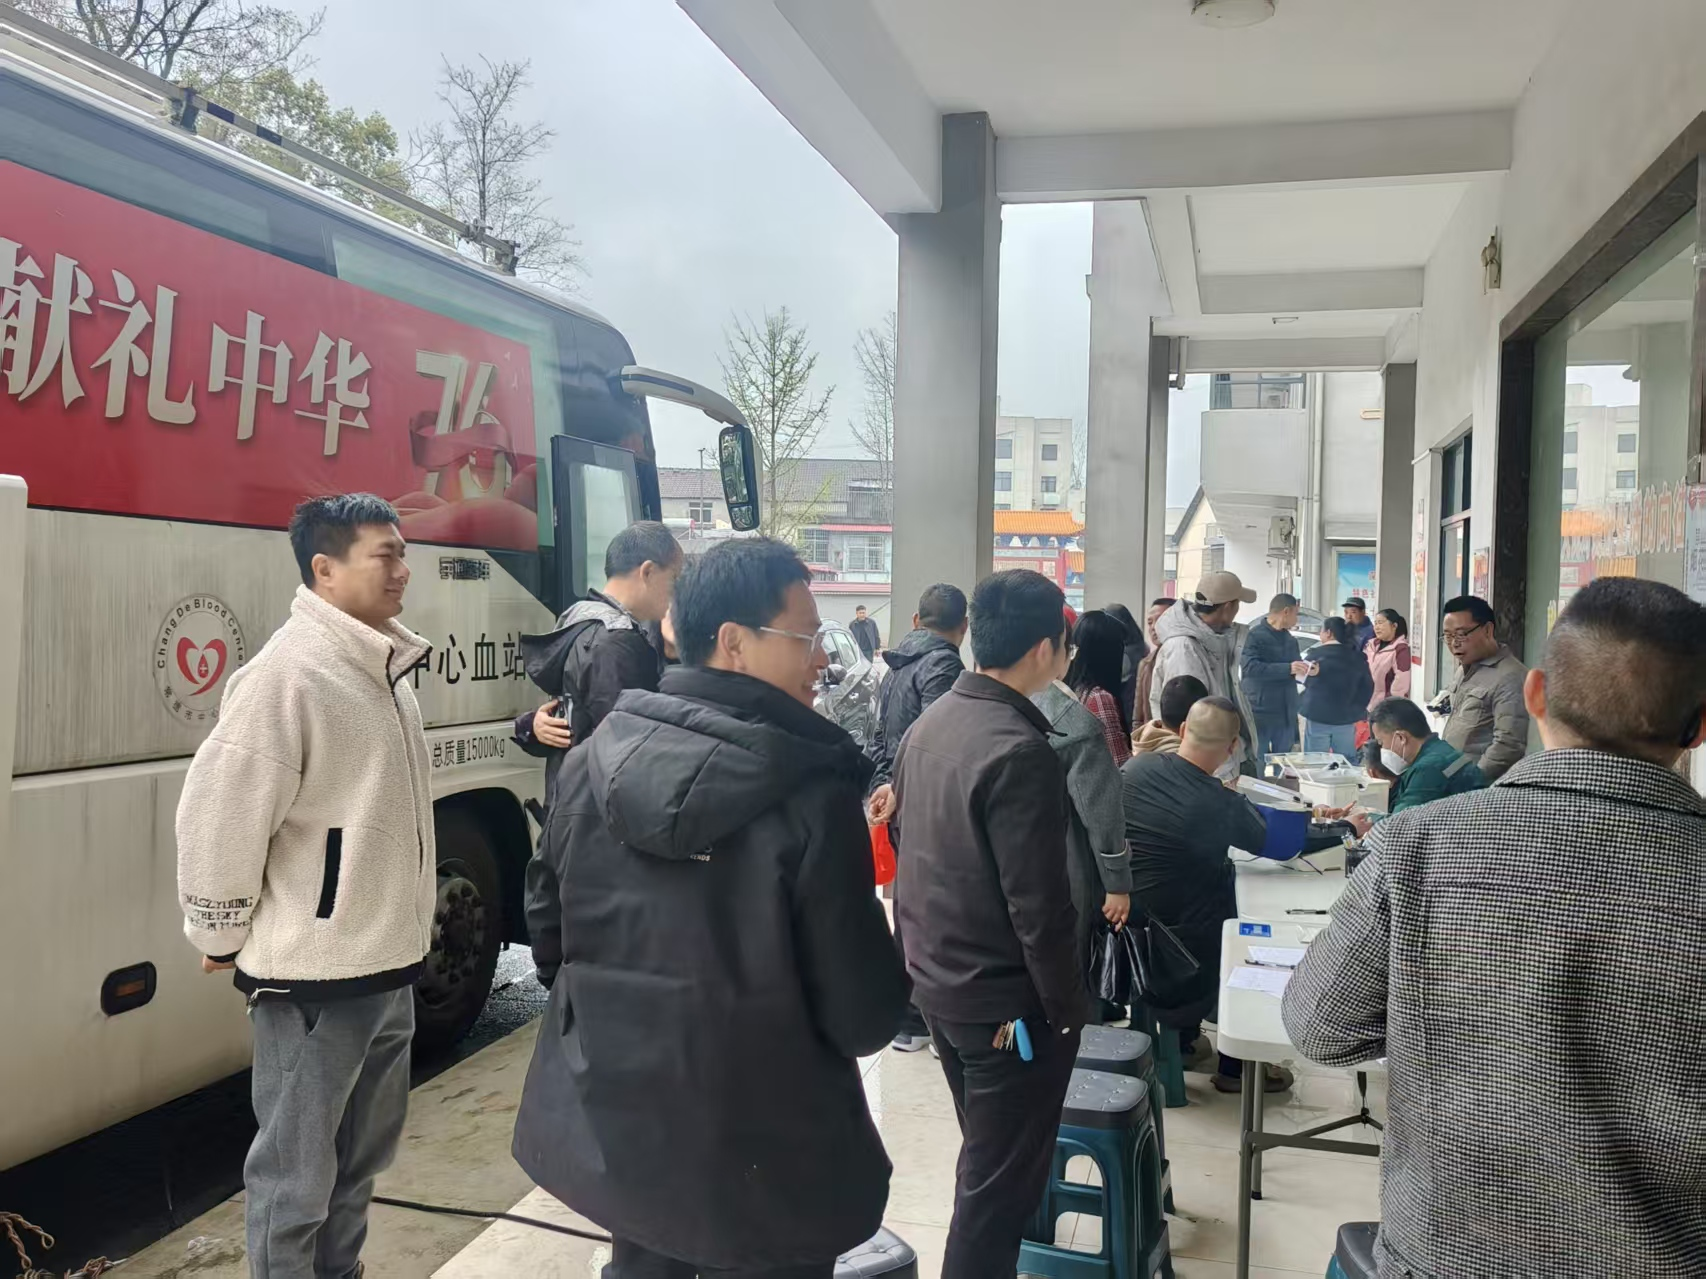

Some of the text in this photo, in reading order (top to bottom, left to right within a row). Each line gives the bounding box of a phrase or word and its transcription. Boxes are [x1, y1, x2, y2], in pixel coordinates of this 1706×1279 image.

[0, 237, 372, 456] 献礼中华
[157, 618, 178, 670] Chang
[176, 603, 191, 618] De
[194, 598, 227, 619] Blood
[432, 735, 505, 768] 总质量15000kg
